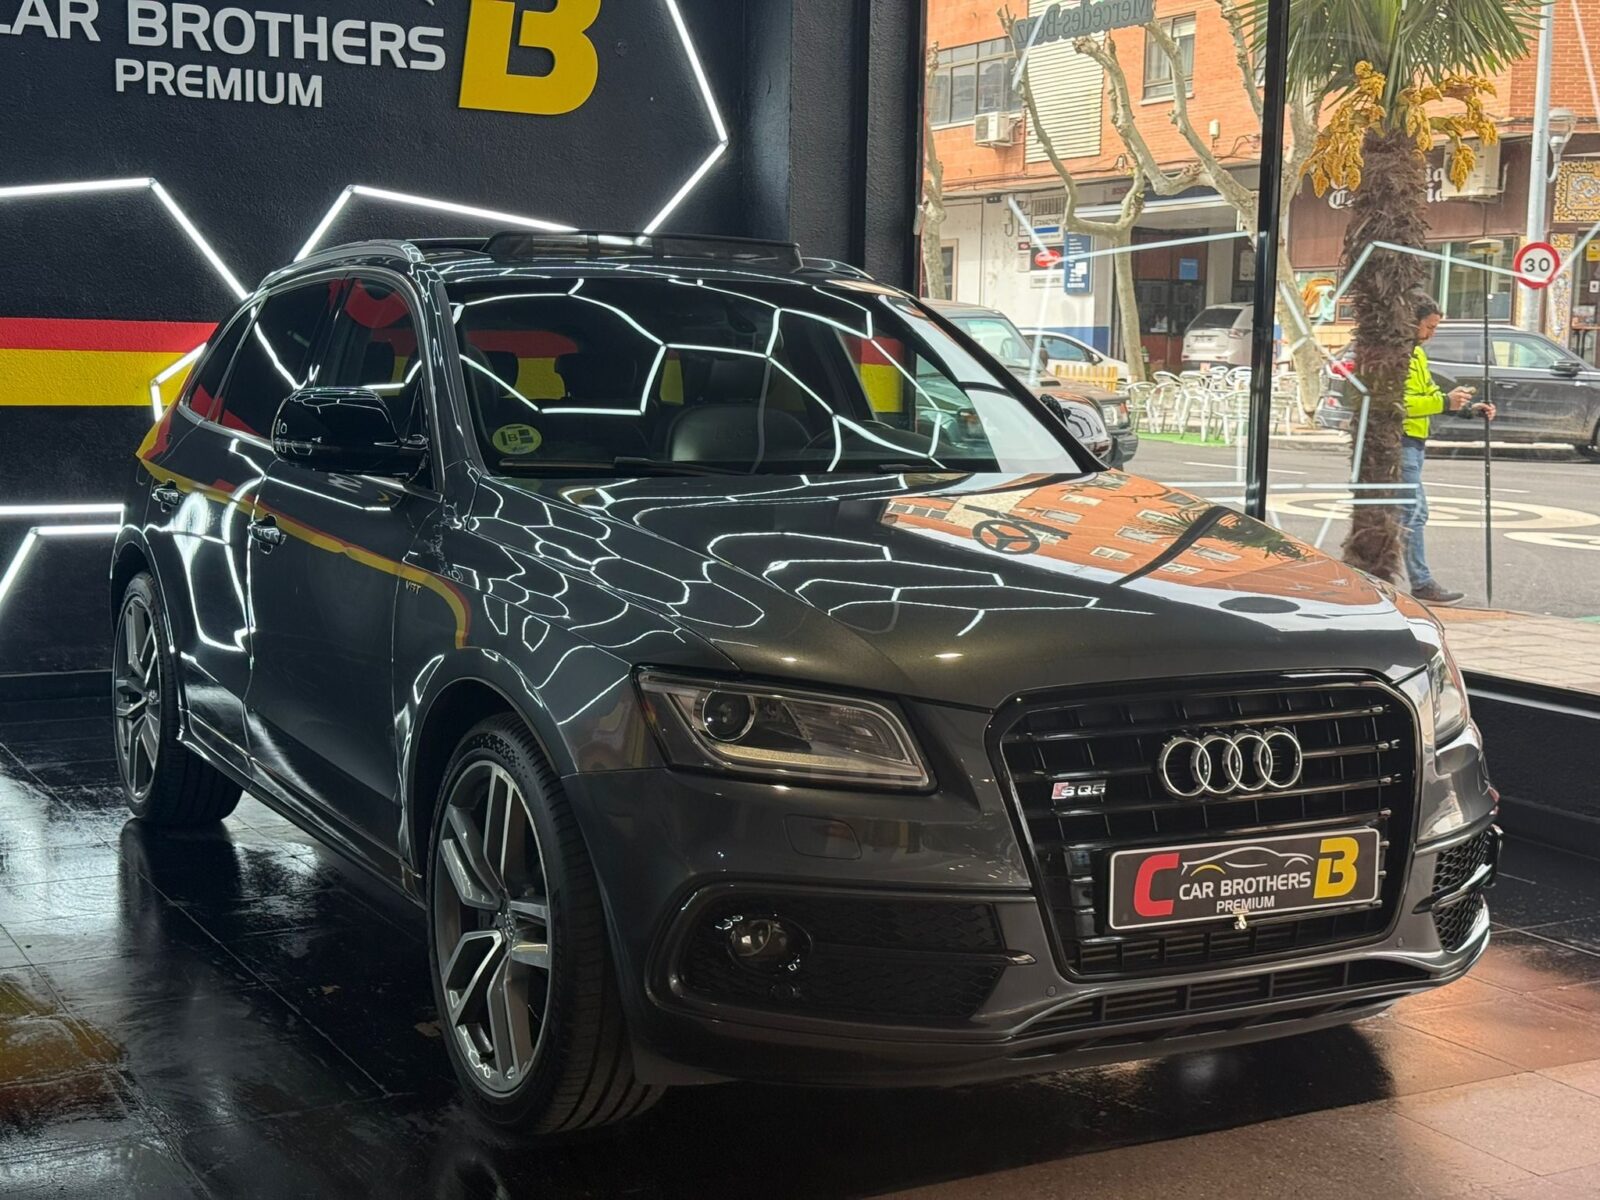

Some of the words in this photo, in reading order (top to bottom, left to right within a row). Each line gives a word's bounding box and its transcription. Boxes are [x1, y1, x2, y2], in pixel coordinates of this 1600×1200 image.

[0, 0, 101, 41] AR
[128, 0, 446, 71] BROTHERS
[458, 0, 601, 115] B
[115, 58, 323, 108] PREMIUM
[1524, 257, 1550, 272] 30
[1060, 783, 1106, 797] SQ5
[1133, 852, 1180, 917] C
[1179, 881, 1214, 900] CAR
[1220, 871, 1312, 897] BROTHERS
[1313, 836, 1359, 899] B
[1216, 895, 1275, 913] PREMIUM
